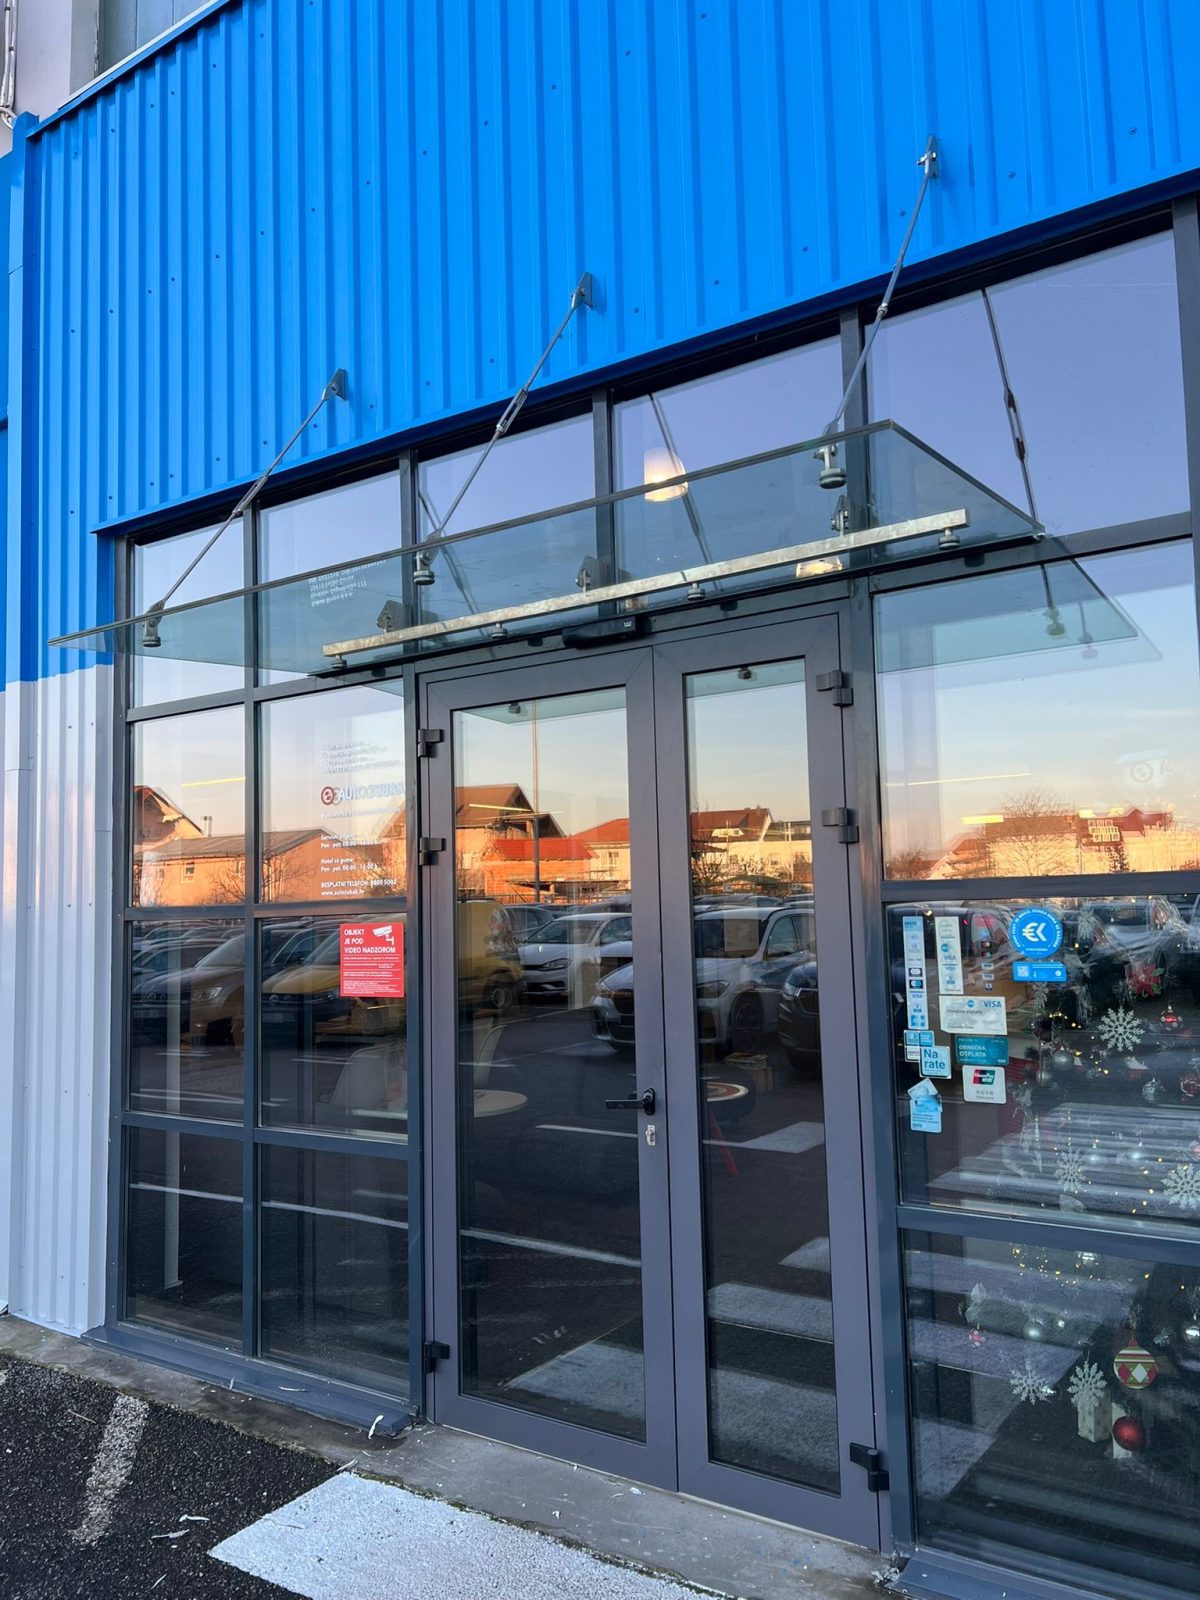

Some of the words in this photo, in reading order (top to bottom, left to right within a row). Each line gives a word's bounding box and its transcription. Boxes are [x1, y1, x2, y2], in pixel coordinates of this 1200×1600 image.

[983, 1000, 1002, 1008] VISA
[923, 1049, 938, 1059] Na
[924, 1060, 946, 1070] rate
